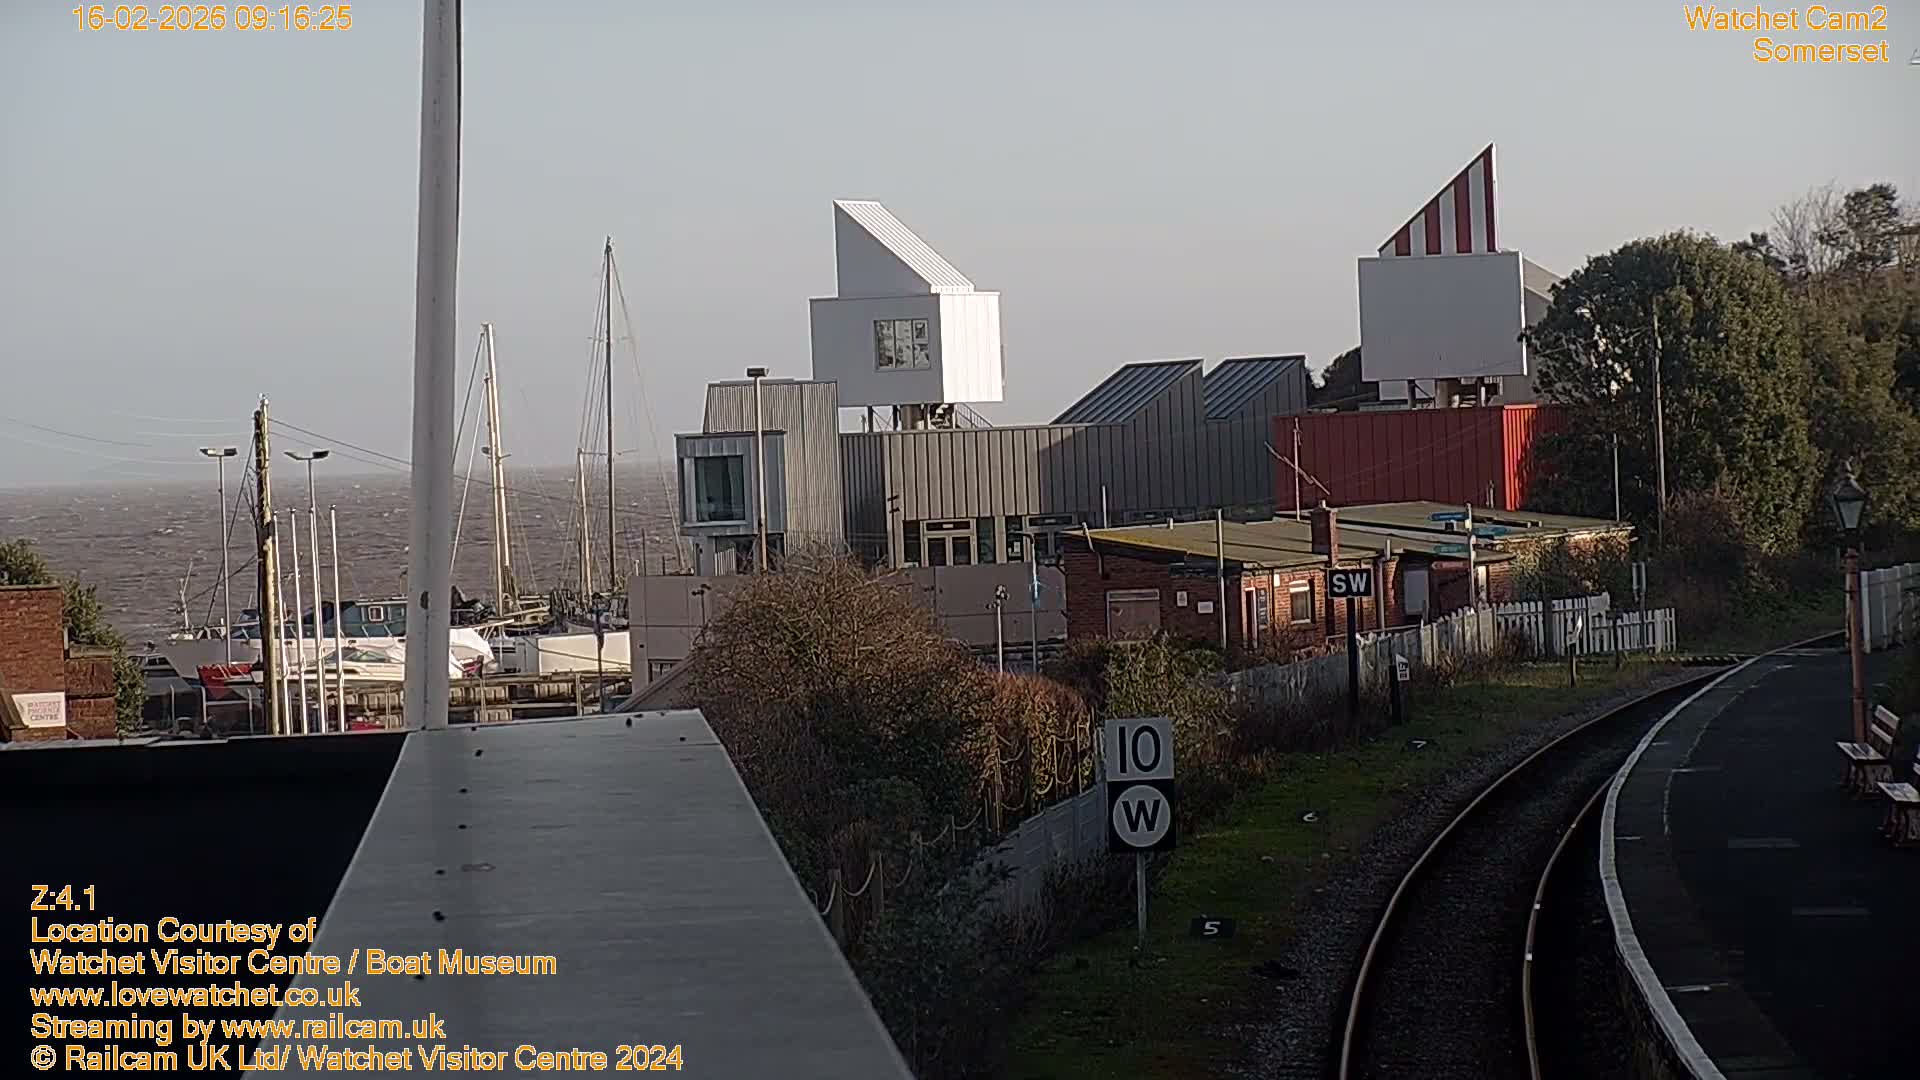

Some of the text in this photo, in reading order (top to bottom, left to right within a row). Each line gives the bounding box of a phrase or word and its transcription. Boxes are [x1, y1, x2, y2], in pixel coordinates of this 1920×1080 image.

[1332, 572, 1367, 592] SW
[1118, 724, 1162, 774] 10
[1121, 799, 1161, 833] W
[1203, 920, 1221, 936] 5
